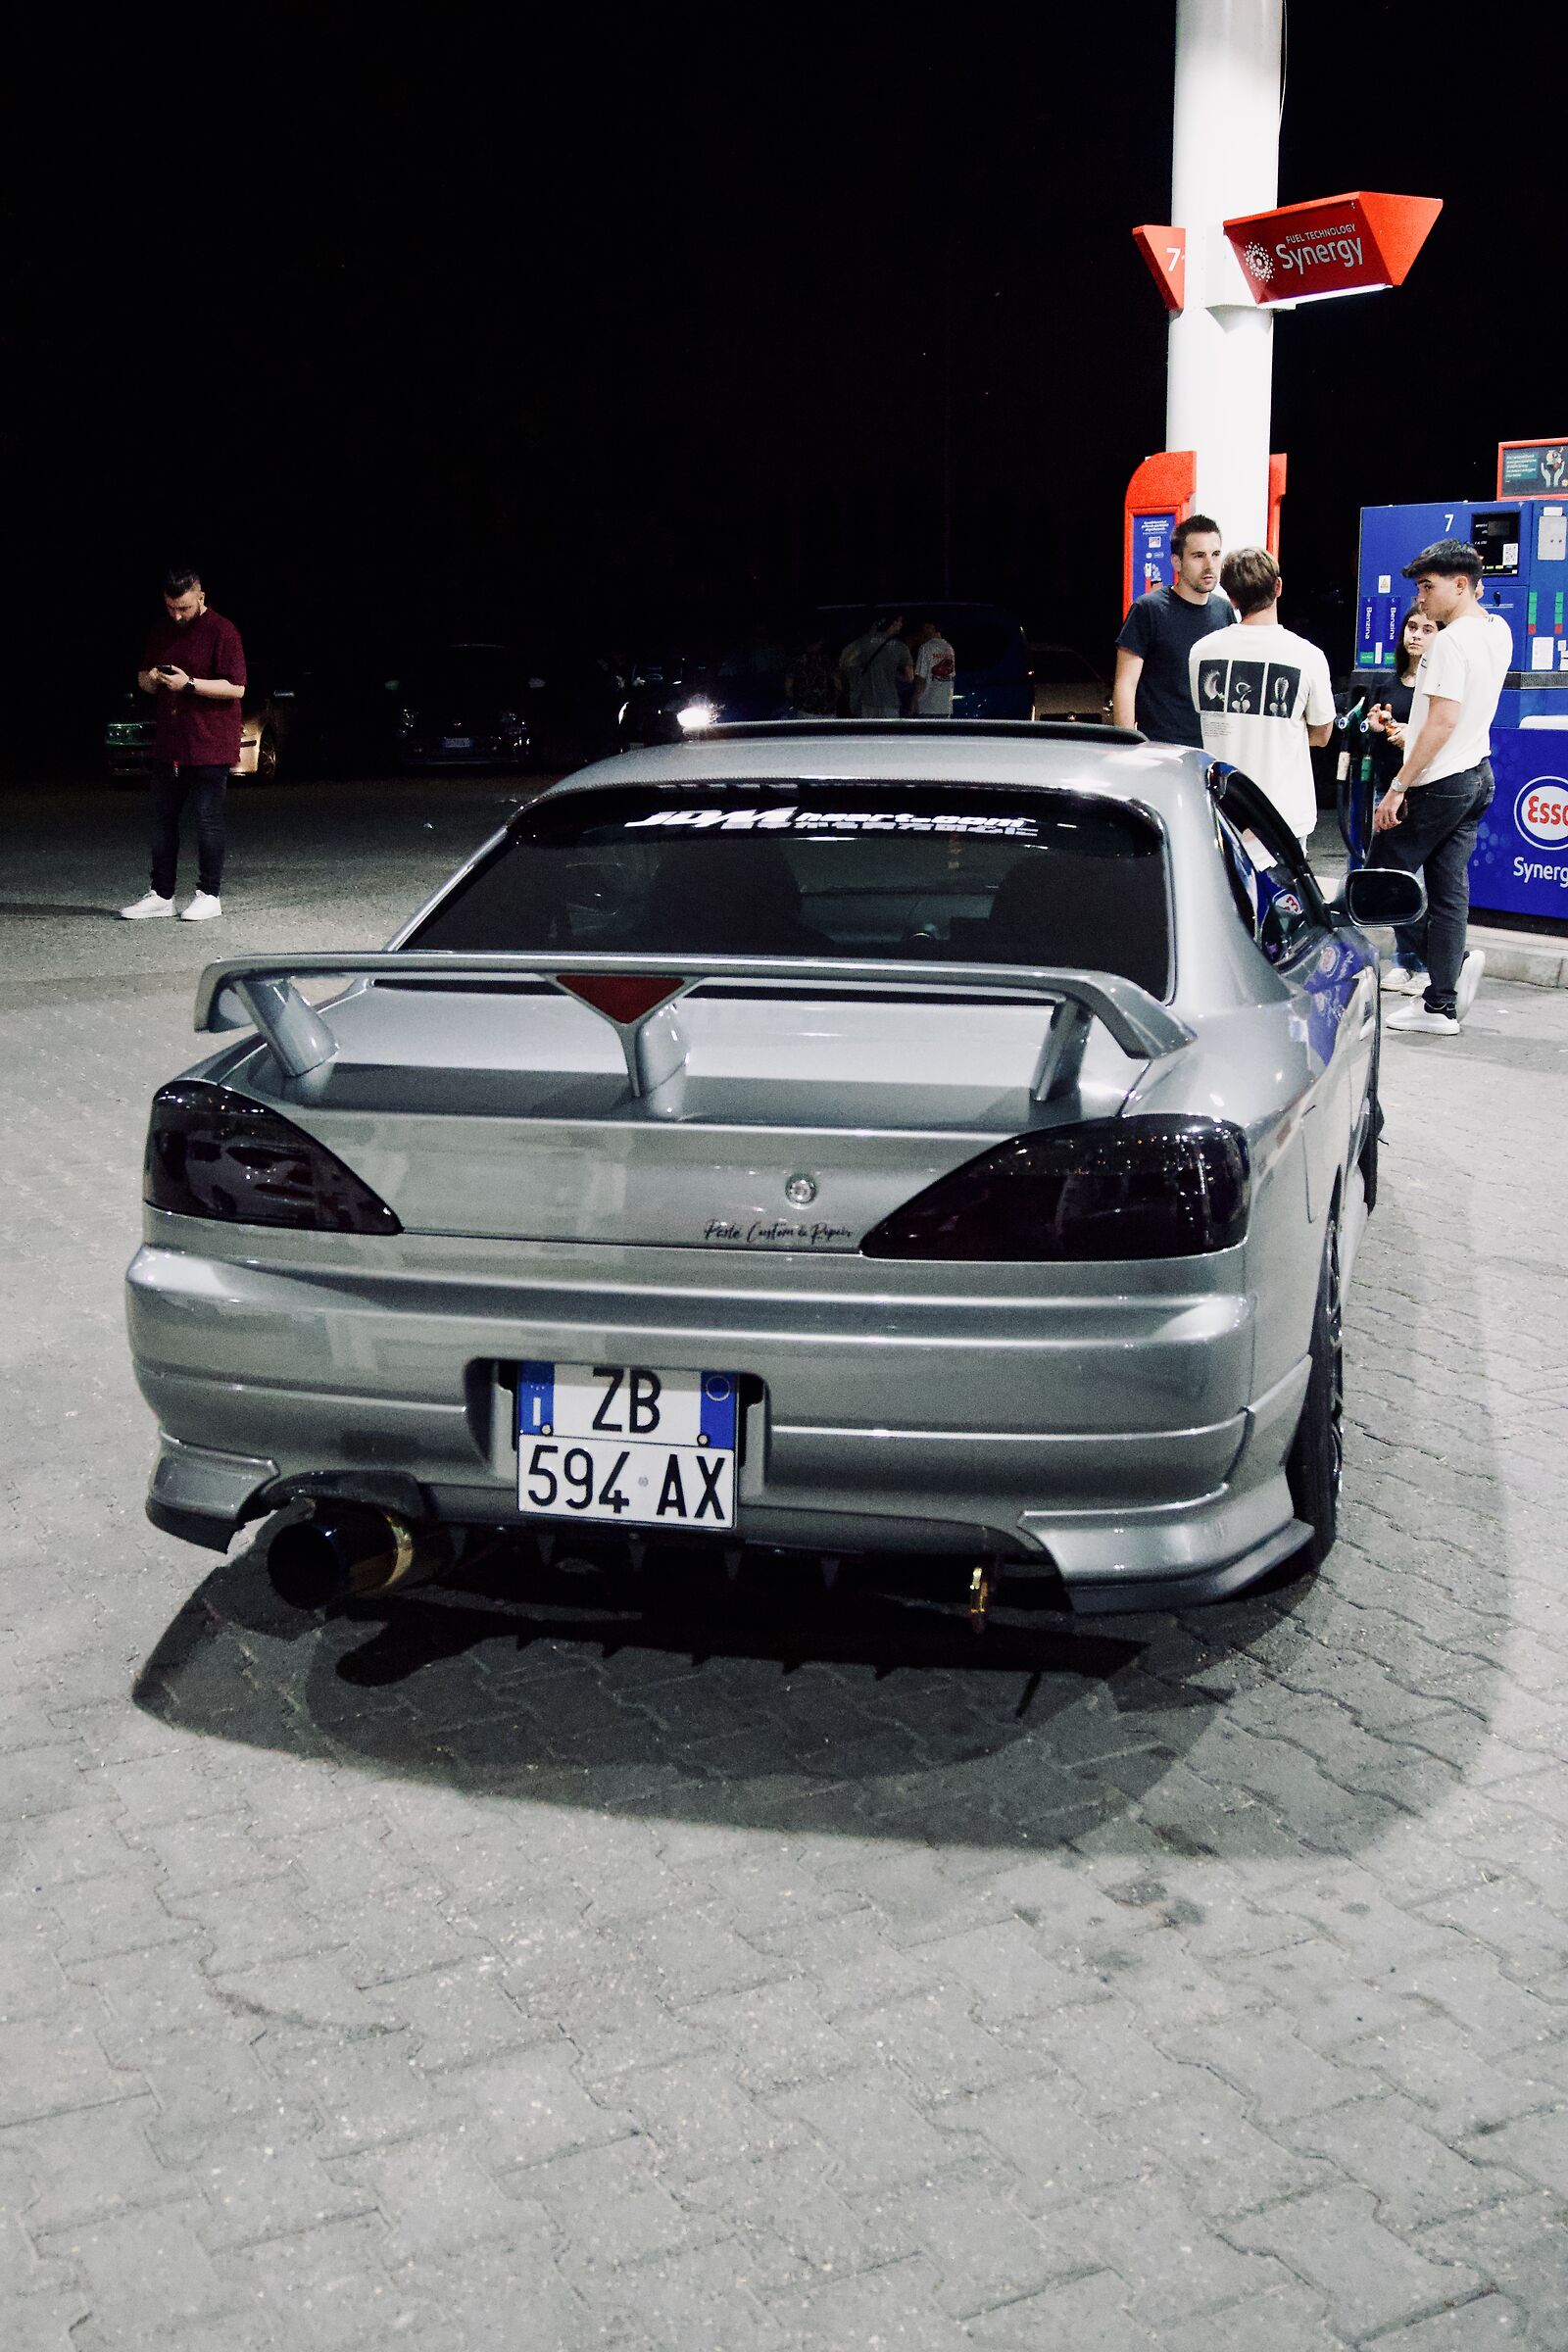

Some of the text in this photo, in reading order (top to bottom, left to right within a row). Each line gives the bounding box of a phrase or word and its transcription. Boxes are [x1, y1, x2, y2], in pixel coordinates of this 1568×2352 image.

[1286, 223, 1356, 244] FUEL TECHNOLOGY
[1166, 247, 1181, 272] 7
[1275, 237, 1363, 275] Synergy
[1445, 514, 1454, 532] 7
[1364, 607, 1373, 640] Benzina
[1389, 607, 1397, 640] Benzina
[1513, 857, 1568, 888] Synerg
[592, 1367, 662, 1434] ZB
[527, 1444, 726, 1521] 594 AX
